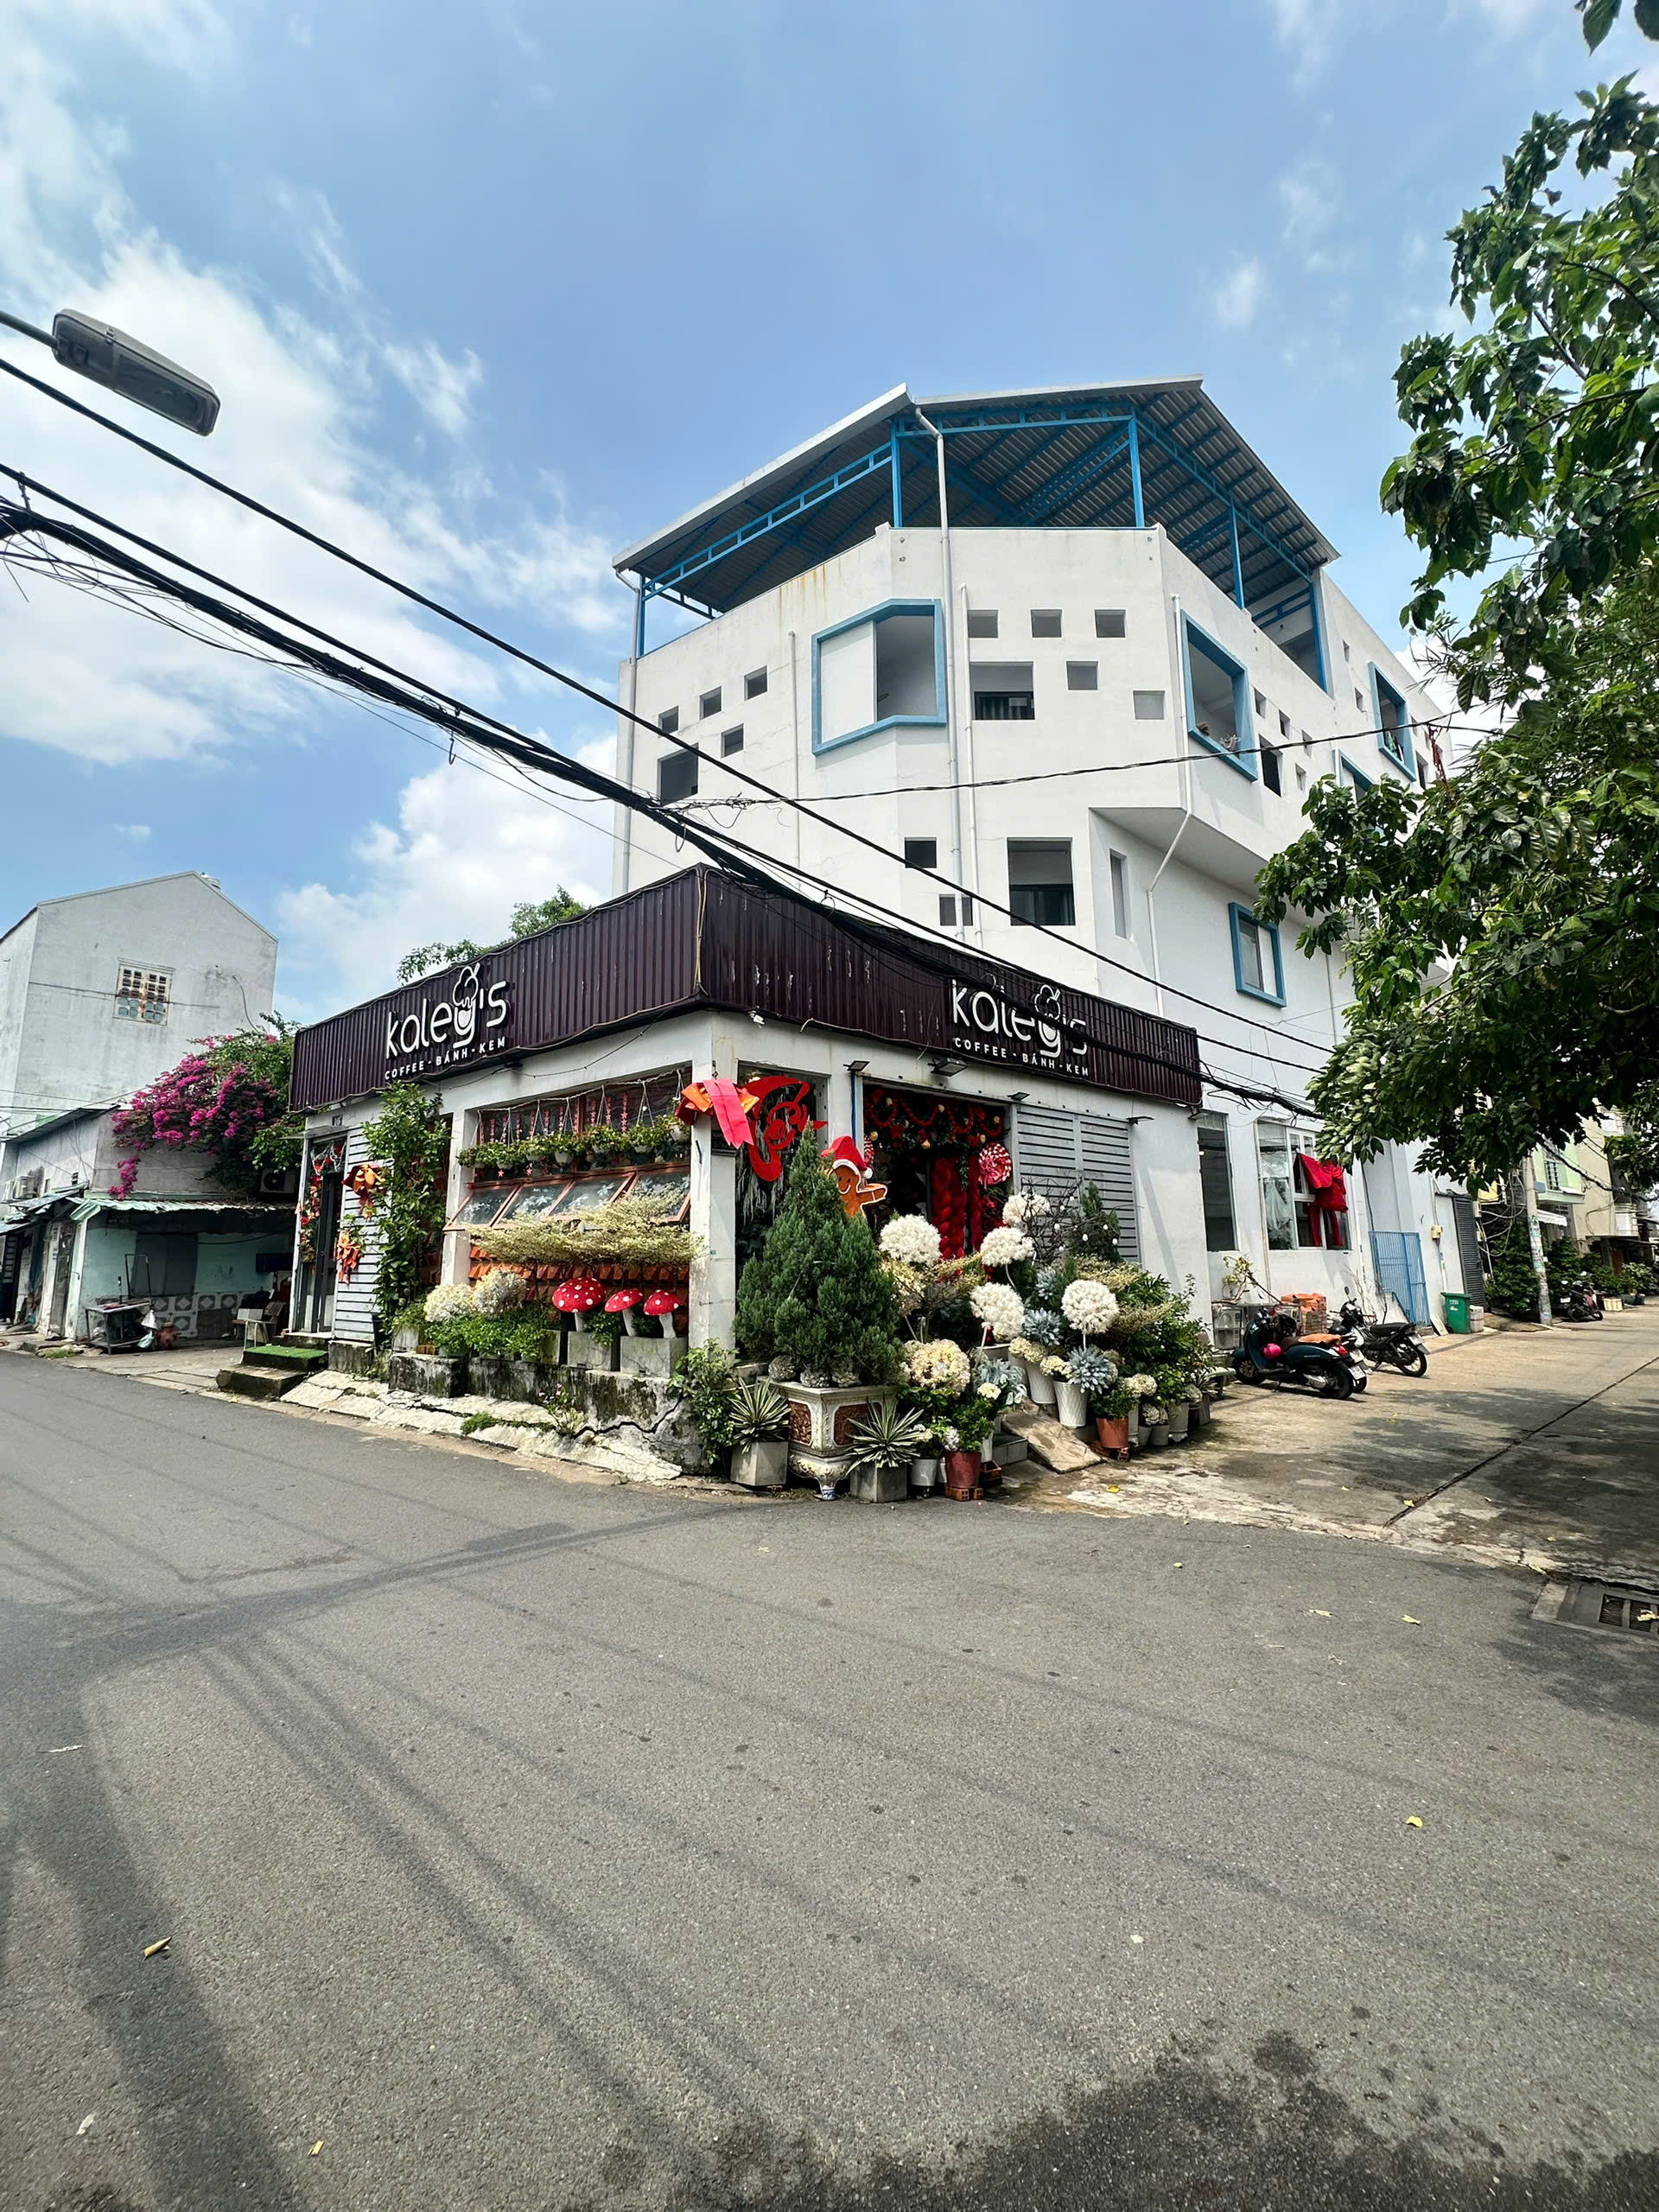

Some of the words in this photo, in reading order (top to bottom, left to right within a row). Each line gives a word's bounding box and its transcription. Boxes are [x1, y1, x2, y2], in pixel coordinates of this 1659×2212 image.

[385, 1060, 424, 1080] COFFEE
[435, 1047, 467, 1066] BÁNH
[479, 1036, 505, 1053] KEM
[954, 1038, 1007, 1058] COFFEE
[1022, 1053, 1055, 1069] BÁNH
[1065, 1063, 1089, 1077] KEM
